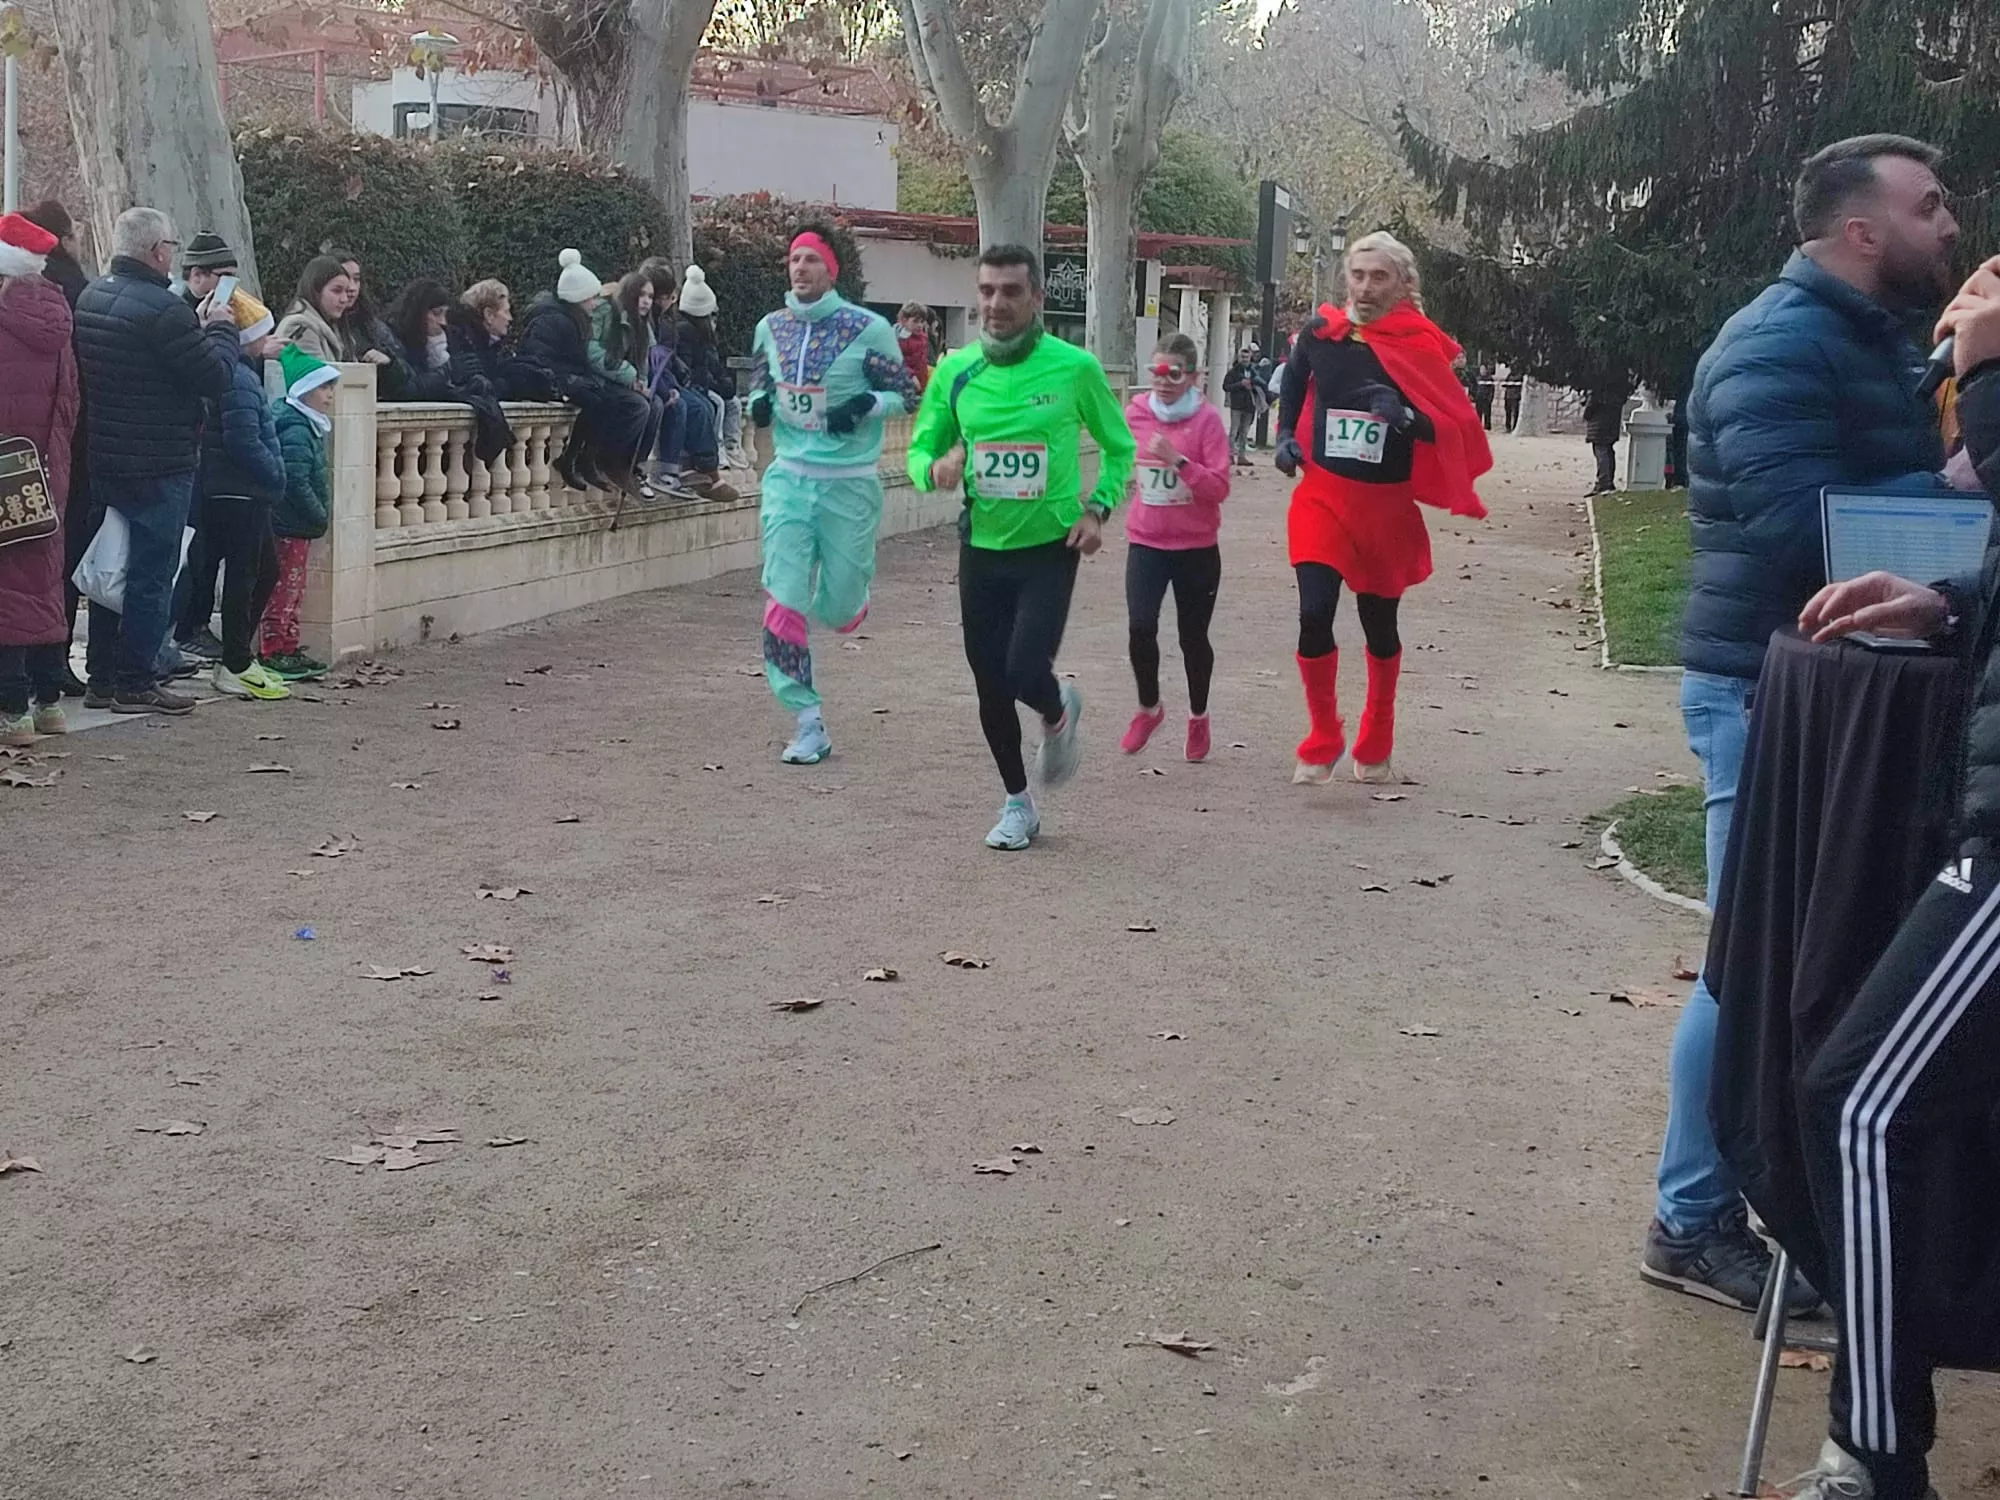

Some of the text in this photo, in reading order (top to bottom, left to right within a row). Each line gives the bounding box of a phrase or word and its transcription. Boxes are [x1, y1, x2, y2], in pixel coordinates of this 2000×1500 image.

[1044, 287, 1077, 302] RQUE
[787, 390, 812, 414] 39
[1337, 418, 1380, 445] 176
[984, 451, 1040, 478] 299
[1149, 468, 1177, 489] 70
